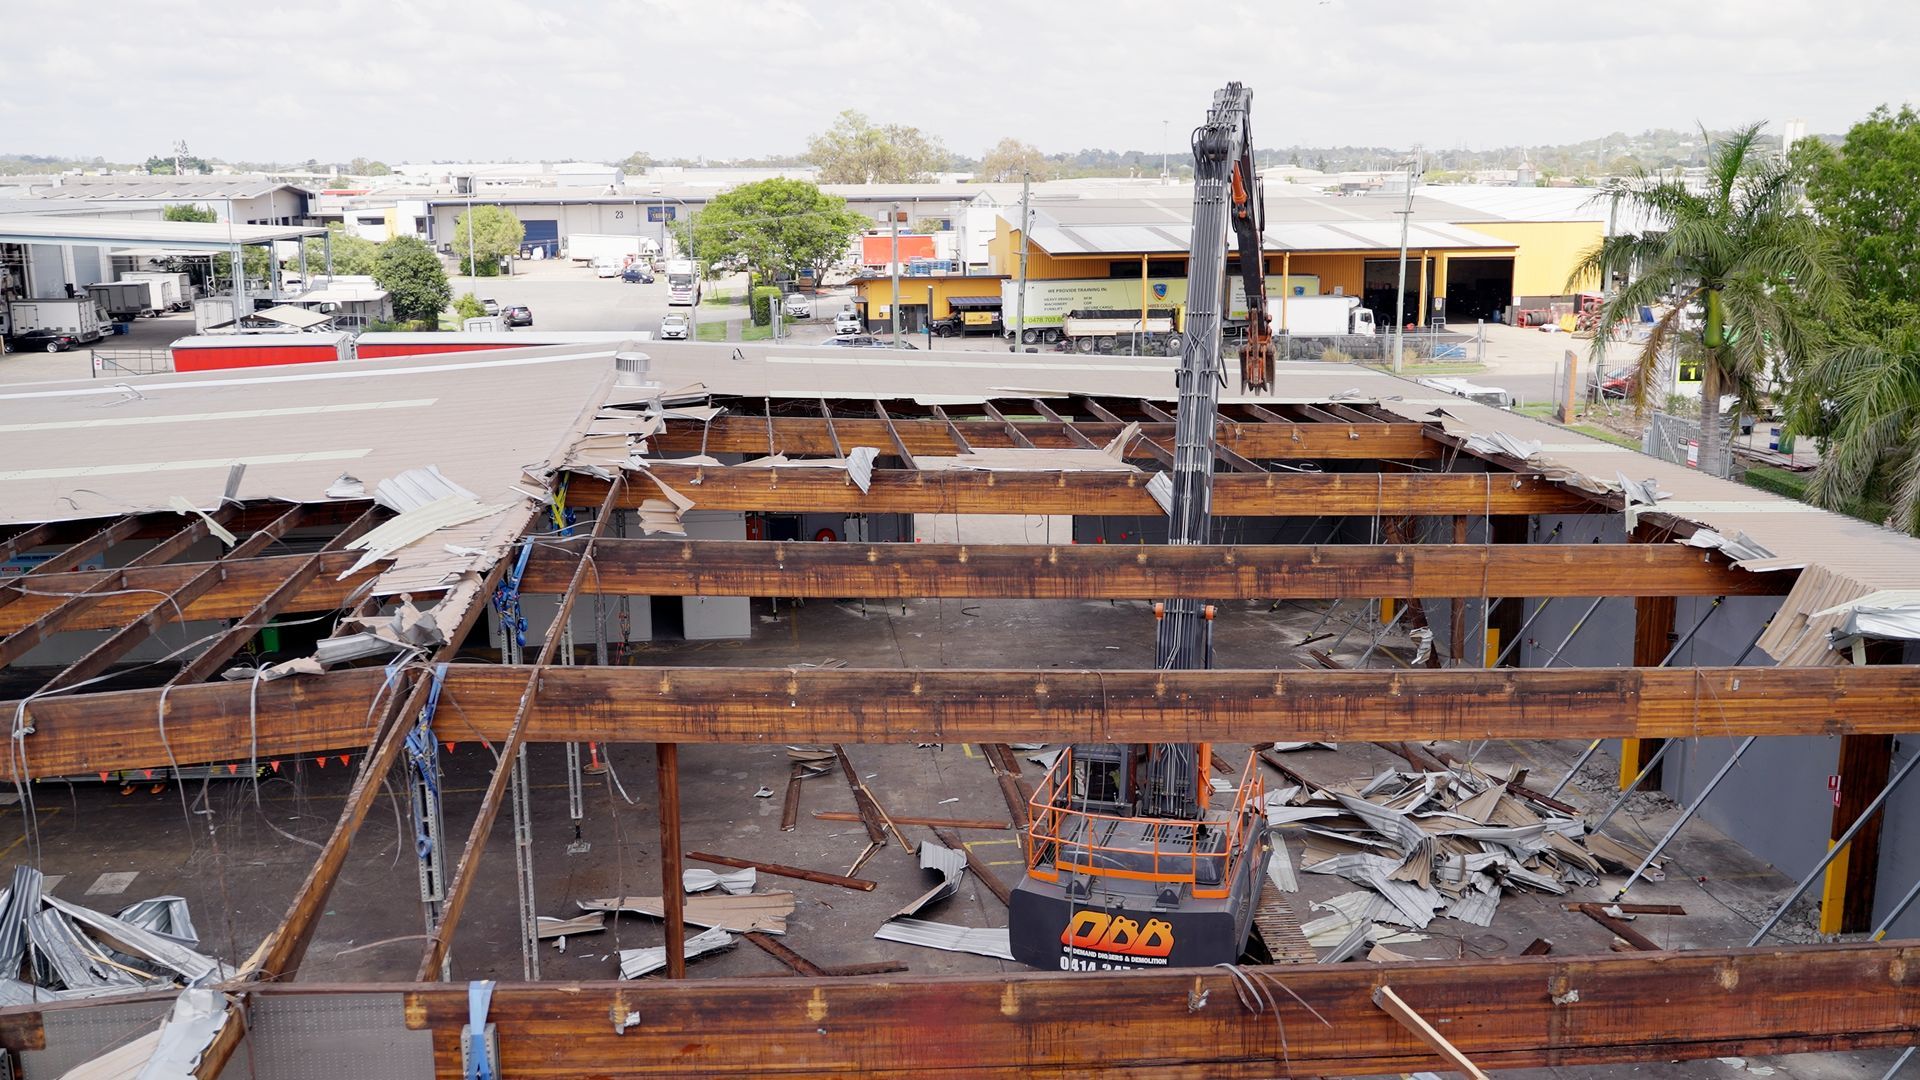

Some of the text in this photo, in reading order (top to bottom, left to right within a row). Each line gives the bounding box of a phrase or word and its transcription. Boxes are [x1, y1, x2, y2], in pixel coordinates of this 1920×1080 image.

[615, 210, 624, 219] 23
[1060, 956, 1096, 971] 0414
[1073, 948, 1097, 958] DEMAND
[1097, 952, 1123, 961] DIGGERS
[1131, 956, 1168, 965] DEMOLITION
